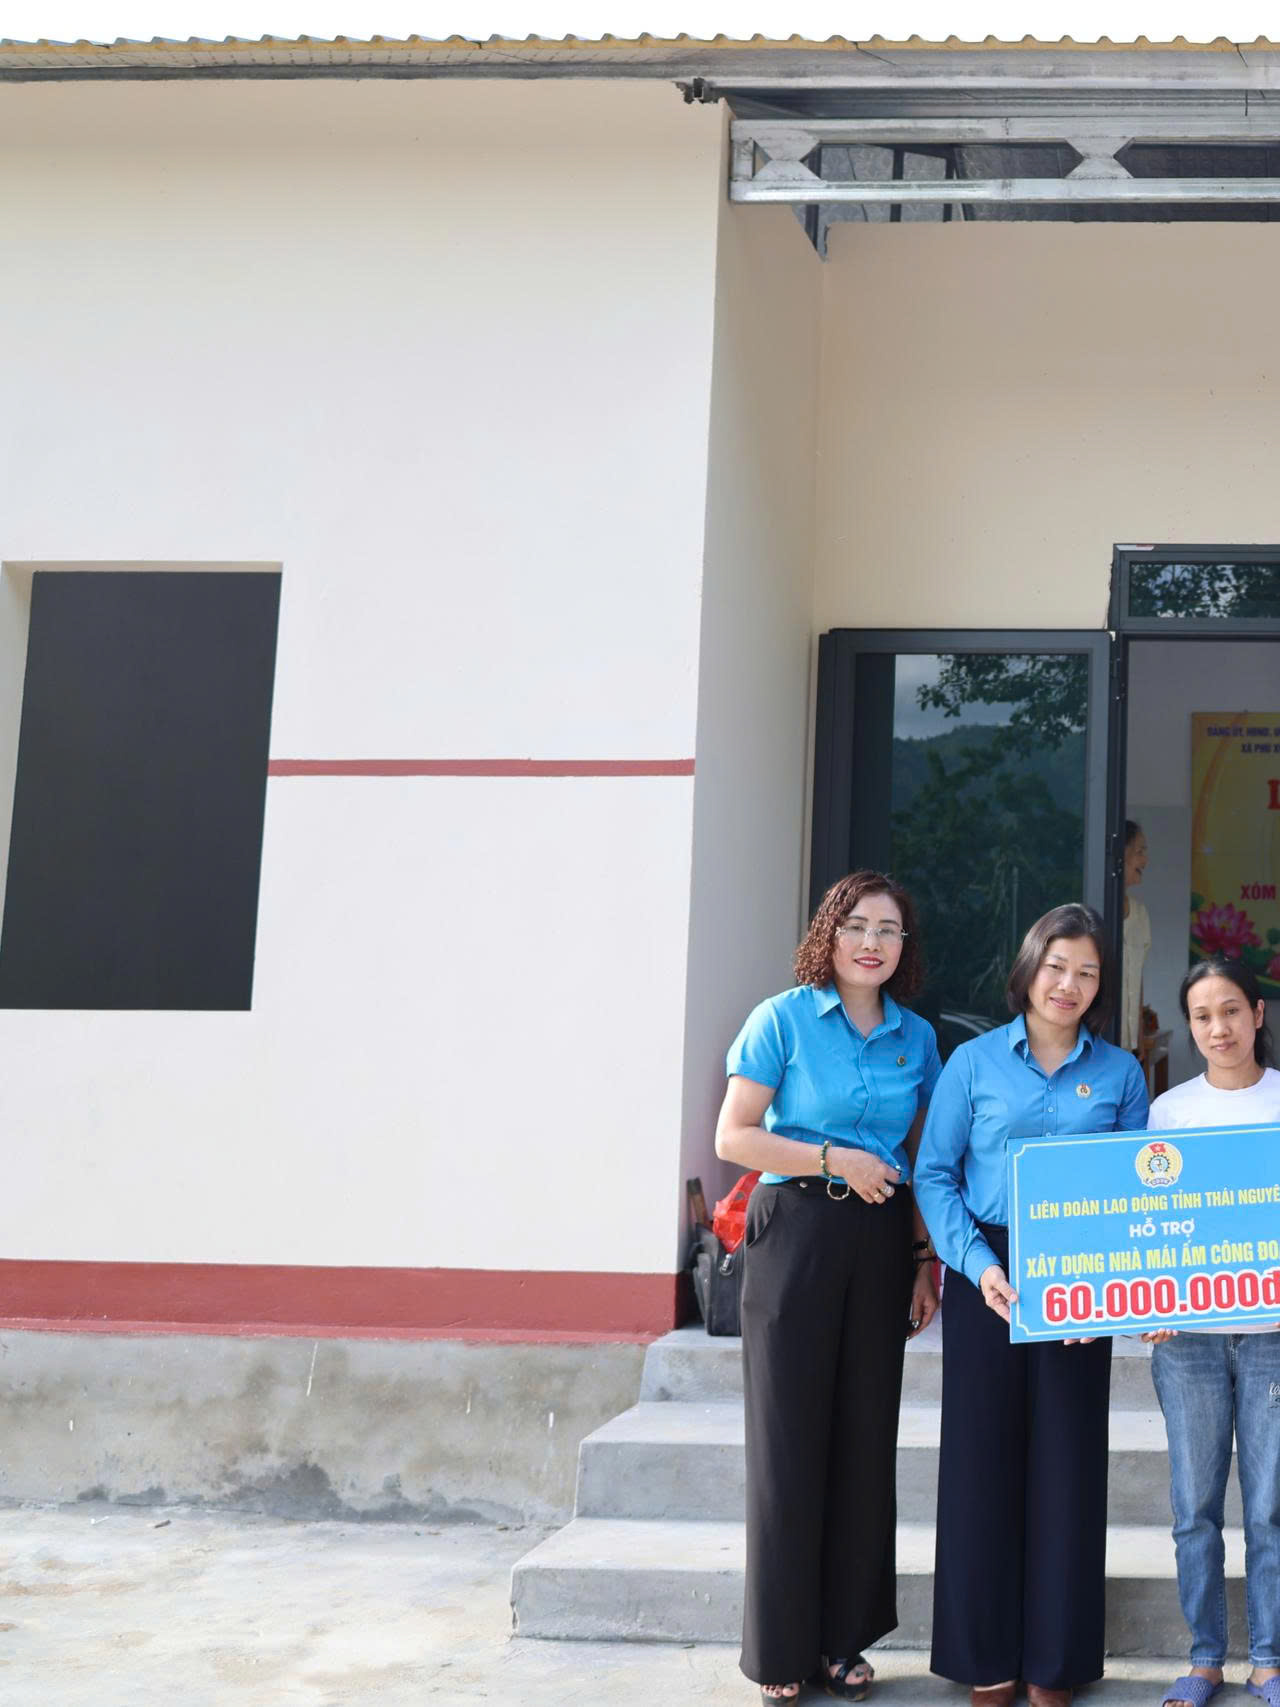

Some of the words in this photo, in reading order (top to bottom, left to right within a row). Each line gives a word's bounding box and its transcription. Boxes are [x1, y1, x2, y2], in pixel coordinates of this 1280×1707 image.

[1240, 882, 1276, 900] XÓM
[1029, 1202, 1060, 1220] LIÊN
[1063, 1198, 1099, 1217] ĐOÀN
[1103, 1198, 1128, 1215] LAO
[1131, 1194, 1168, 1216] ĐỘNG
[1171, 1189, 1202, 1210] TỈNH
[1205, 1187, 1235, 1208] THÁI
[1129, 1217, 1157, 1239] HỖ
[1161, 1218, 1195, 1238] TRỢ
[1026, 1253, 1057, 1278] XÂY
[1060, 1255, 1105, 1280] DỰNG
[1109, 1246, 1143, 1272] NHÀ
[1146, 1244, 1177, 1269] MÁI
[1181, 1239, 1207, 1267] ẤM
[1210, 1240, 1254, 1264] CÔNG
